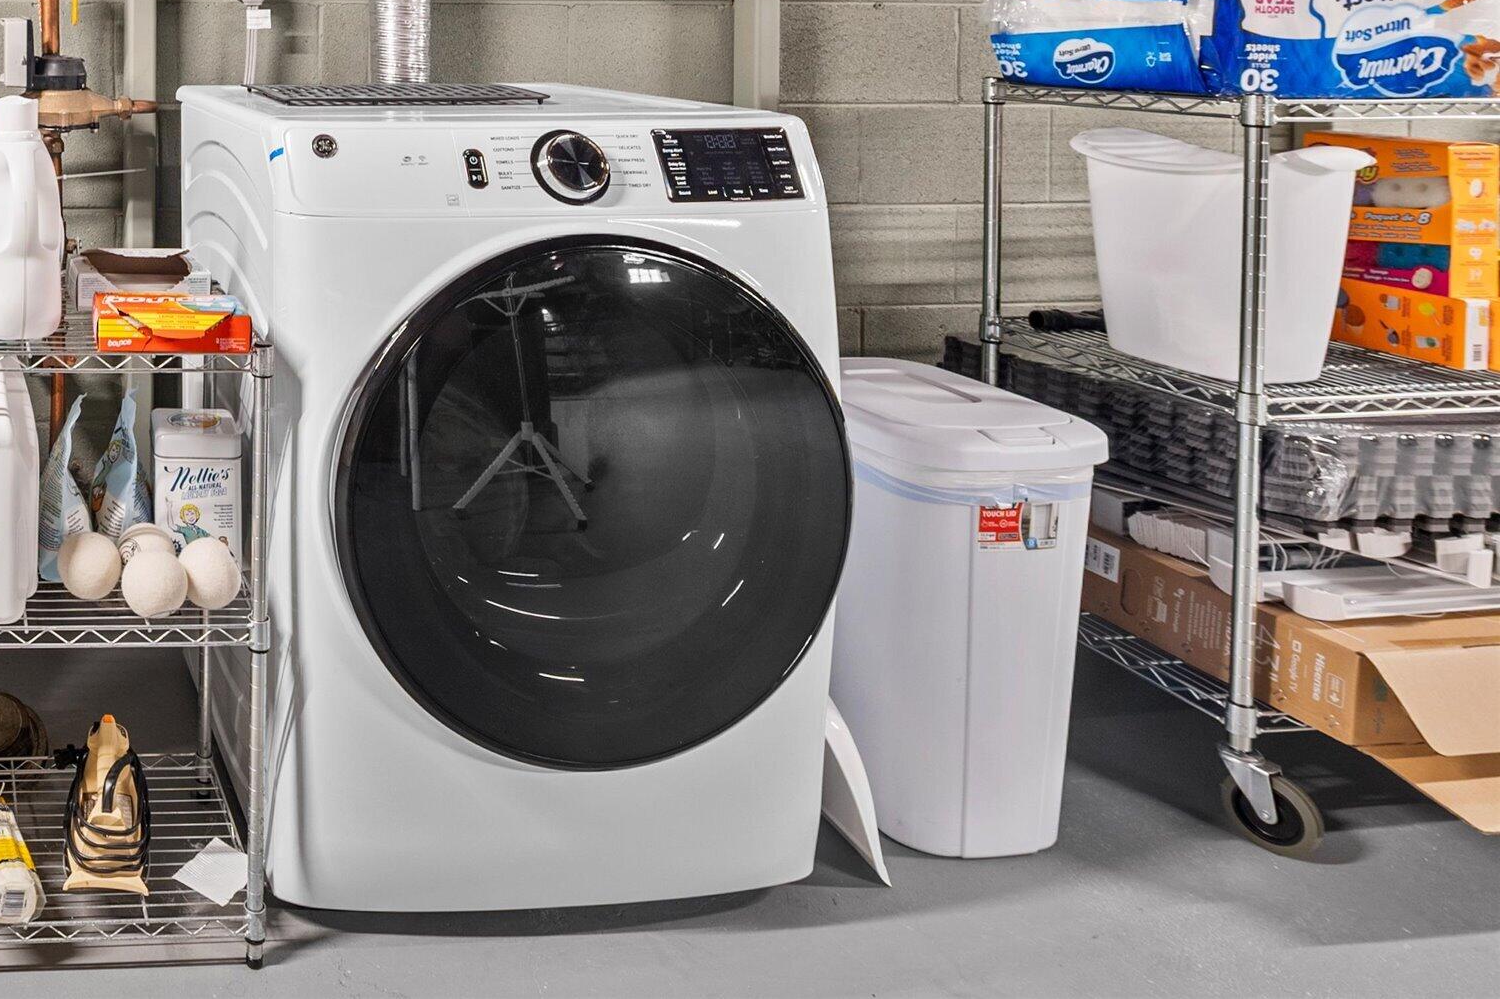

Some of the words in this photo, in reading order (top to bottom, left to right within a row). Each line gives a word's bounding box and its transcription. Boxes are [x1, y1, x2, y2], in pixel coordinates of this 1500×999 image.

[1255, 6, 1295, 14] SMOOTH
[1345, 27, 1372, 42] Soft
[1375, 17, 1410, 35] Ultra
[1066, 56, 1109, 76] Charmin
[1247, 53, 1278, 63] wider
[1358, 46, 1447, 79] Charmin
[1240, 69, 1279, 92] 30
[1418, 211, 1431, 225] 8
[164, 466, 230, 491] Nellie's
[1288, 654, 1300, 681] Google
[1312, 653, 1326, 701] Hisense
[1288, 681, 1299, 693] TV
